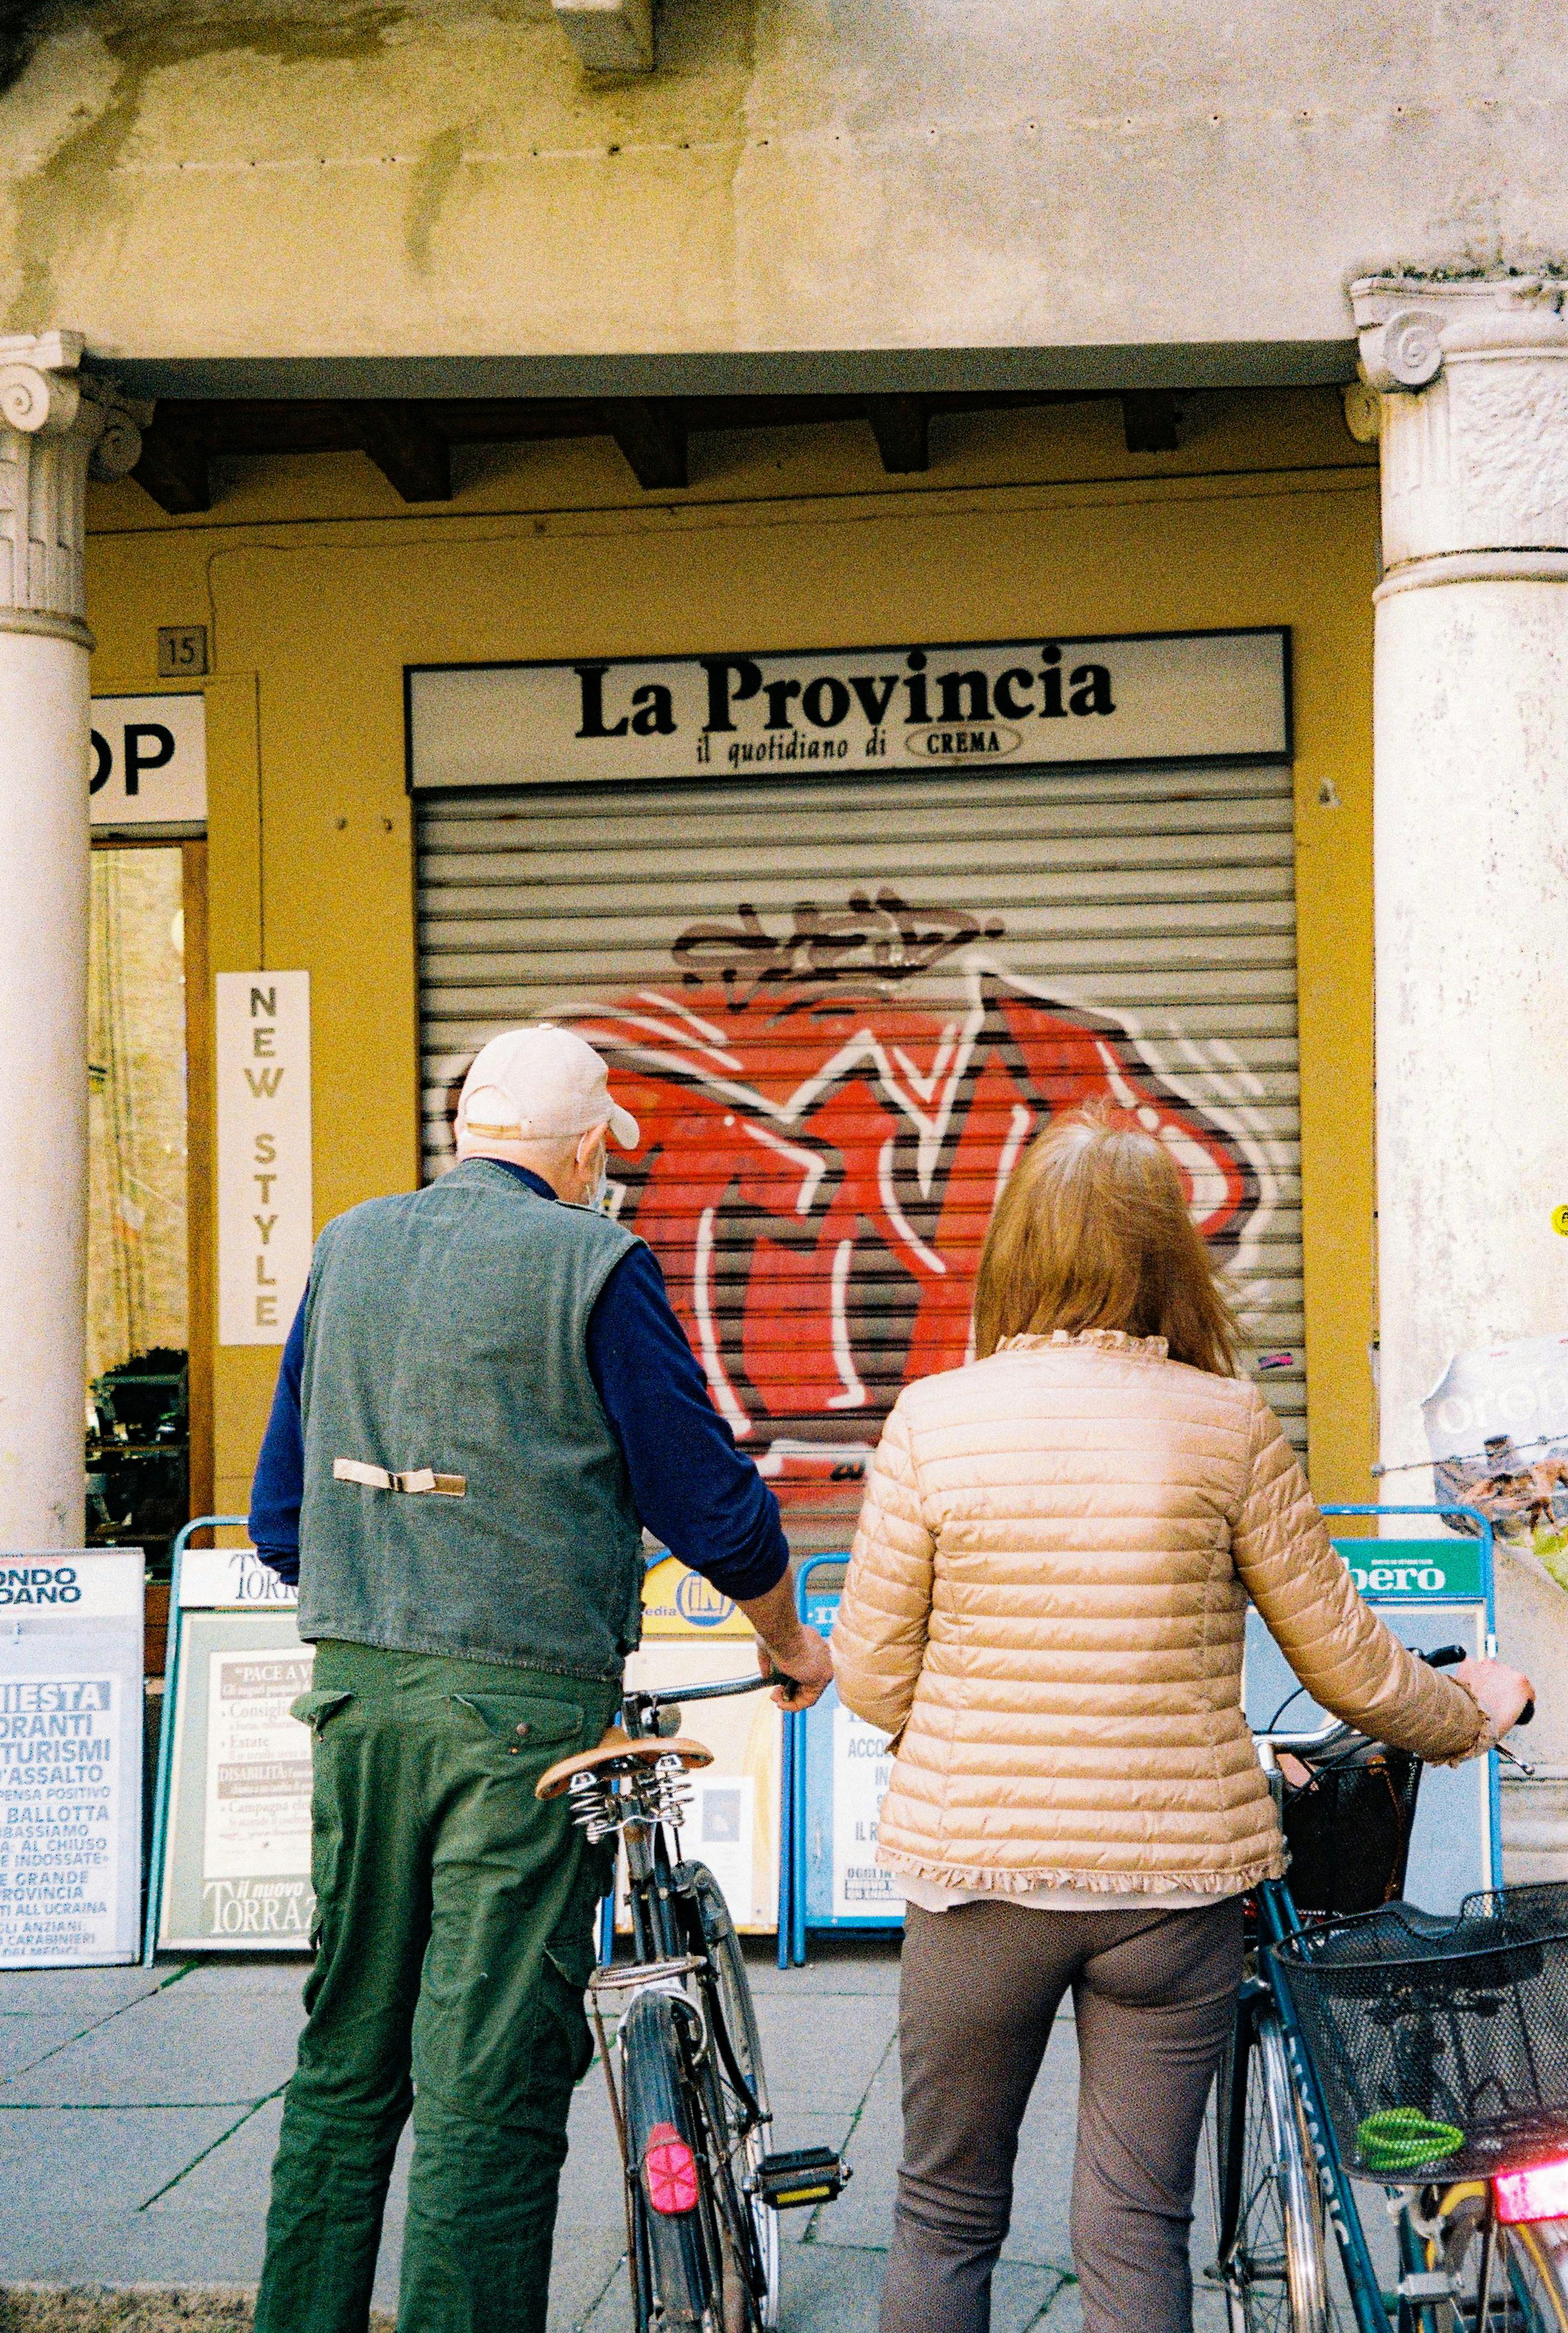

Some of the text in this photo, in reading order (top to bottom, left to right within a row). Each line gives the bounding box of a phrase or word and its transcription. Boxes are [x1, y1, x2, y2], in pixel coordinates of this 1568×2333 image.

[169, 637, 194, 665] 15
[575, 646, 1116, 738] La Provincia
[696, 727, 1000, 768] il quotidiano di CREMA
[243, 987, 284, 1099] NEW
[253, 1133, 278, 1327] STYLE
[47, 1785, 111, 1800] POSITIVO
[7, 1805, 109, 1824] BALLOTTA
[0, 1824, 89, 1839] BASSIAMO
[47, 1837, 107, 1851] CHIUSO
[15, 1870, 88, 1885] GRANDE
[0, 1886, 83, 1901] ROVINCIA
[253, 1882, 304, 1898] nuovo
